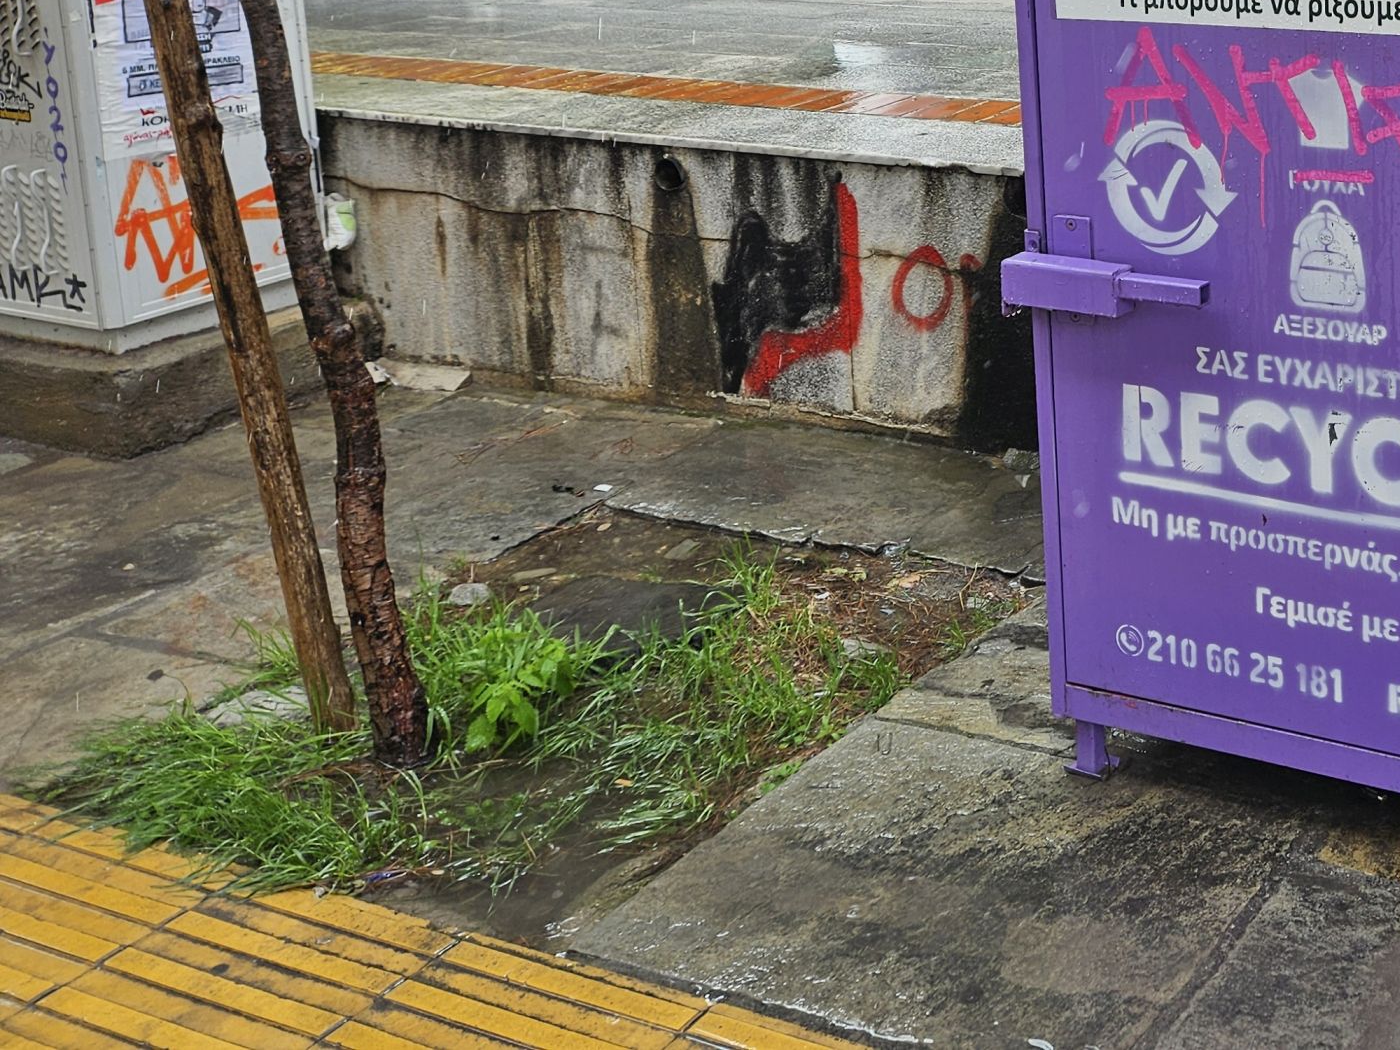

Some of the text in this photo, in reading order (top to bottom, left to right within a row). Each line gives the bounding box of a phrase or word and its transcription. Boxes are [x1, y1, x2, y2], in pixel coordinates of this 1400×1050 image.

[1273, 313, 1388, 345] ΑΞΕΣΟΥΑΡ
[1196, 346, 1249, 379] ΣΑΣ
[1112, 497, 1159, 538] Μη
[1166, 513, 1202, 542] με
[1362, 614, 1400, 643] με
[1147, 630, 1344, 703] 210 66 25 181
